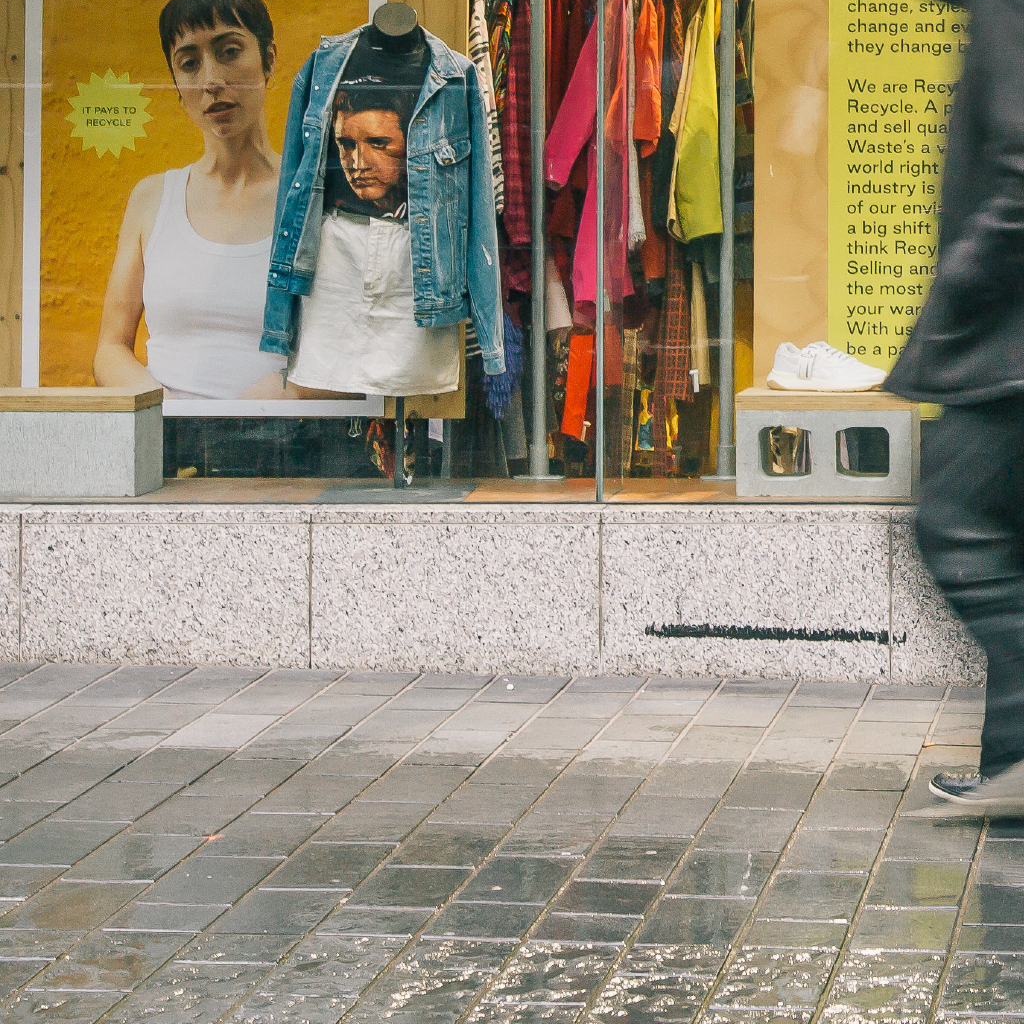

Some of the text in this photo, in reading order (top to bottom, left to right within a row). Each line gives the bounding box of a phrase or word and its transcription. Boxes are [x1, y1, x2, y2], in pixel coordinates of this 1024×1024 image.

[847, 0, 914, 16] change,
[847, 19, 909, 37] change
[914, 19, 945, 33] and
[847, 39, 887, 57] they
[890, 39, 952, 57] change
[847, 78, 877, 94] We
[882, 83, 908, 94] are
[82, 106, 137, 115] IT PAYS TO
[847, 99, 918, 117] Recycle.
[923, 99, 938, 114] A
[86, 118, 132, 127] RECYCLE
[847, 119, 878, 134] and
[883, 119, 911, 134] sell
[847, 139, 915, 154] Waste's
[920, 143, 931, 154] a
[847, 159, 939, 177] world right
[847, 179, 917, 198] industry
[922, 180, 935, 195] is
[847, 199, 864, 215] of
[868, 204, 897, 215] our
[847, 224, 857, 235] a
[862, 220, 887, 238] big
[893, 220, 931, 235] shift
[847, 240, 889, 255] think
[847, 260, 903, 278] Selling
[847, 280, 923, 296] the most
[847, 305, 884, 318] your
[847, 320, 888, 336] With
[846, 341, 867, 356] be
[872, 345, 882, 356] a
